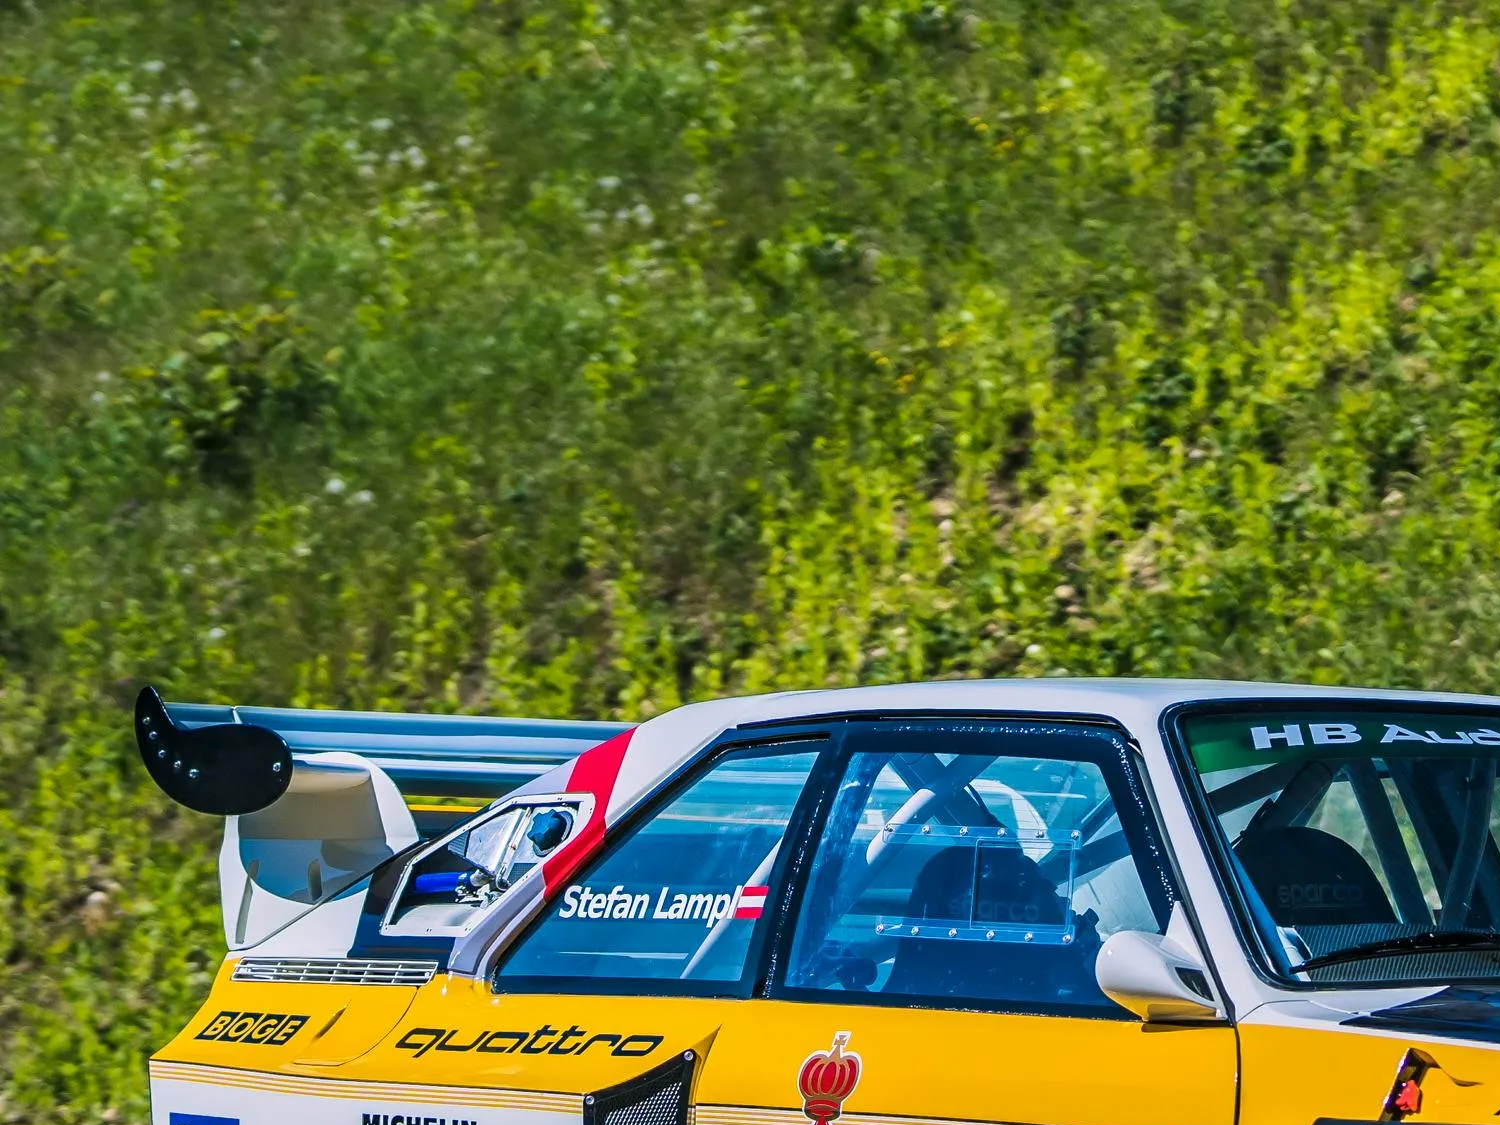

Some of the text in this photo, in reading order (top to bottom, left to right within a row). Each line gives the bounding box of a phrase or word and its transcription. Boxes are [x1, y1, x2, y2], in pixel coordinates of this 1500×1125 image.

[1249, 722, 1362, 750] HB
[558, 885, 741, 928] Stefan Lampl
[203, 1012, 303, 1044] BOGE
[395, 1024, 665, 1058] quattro
